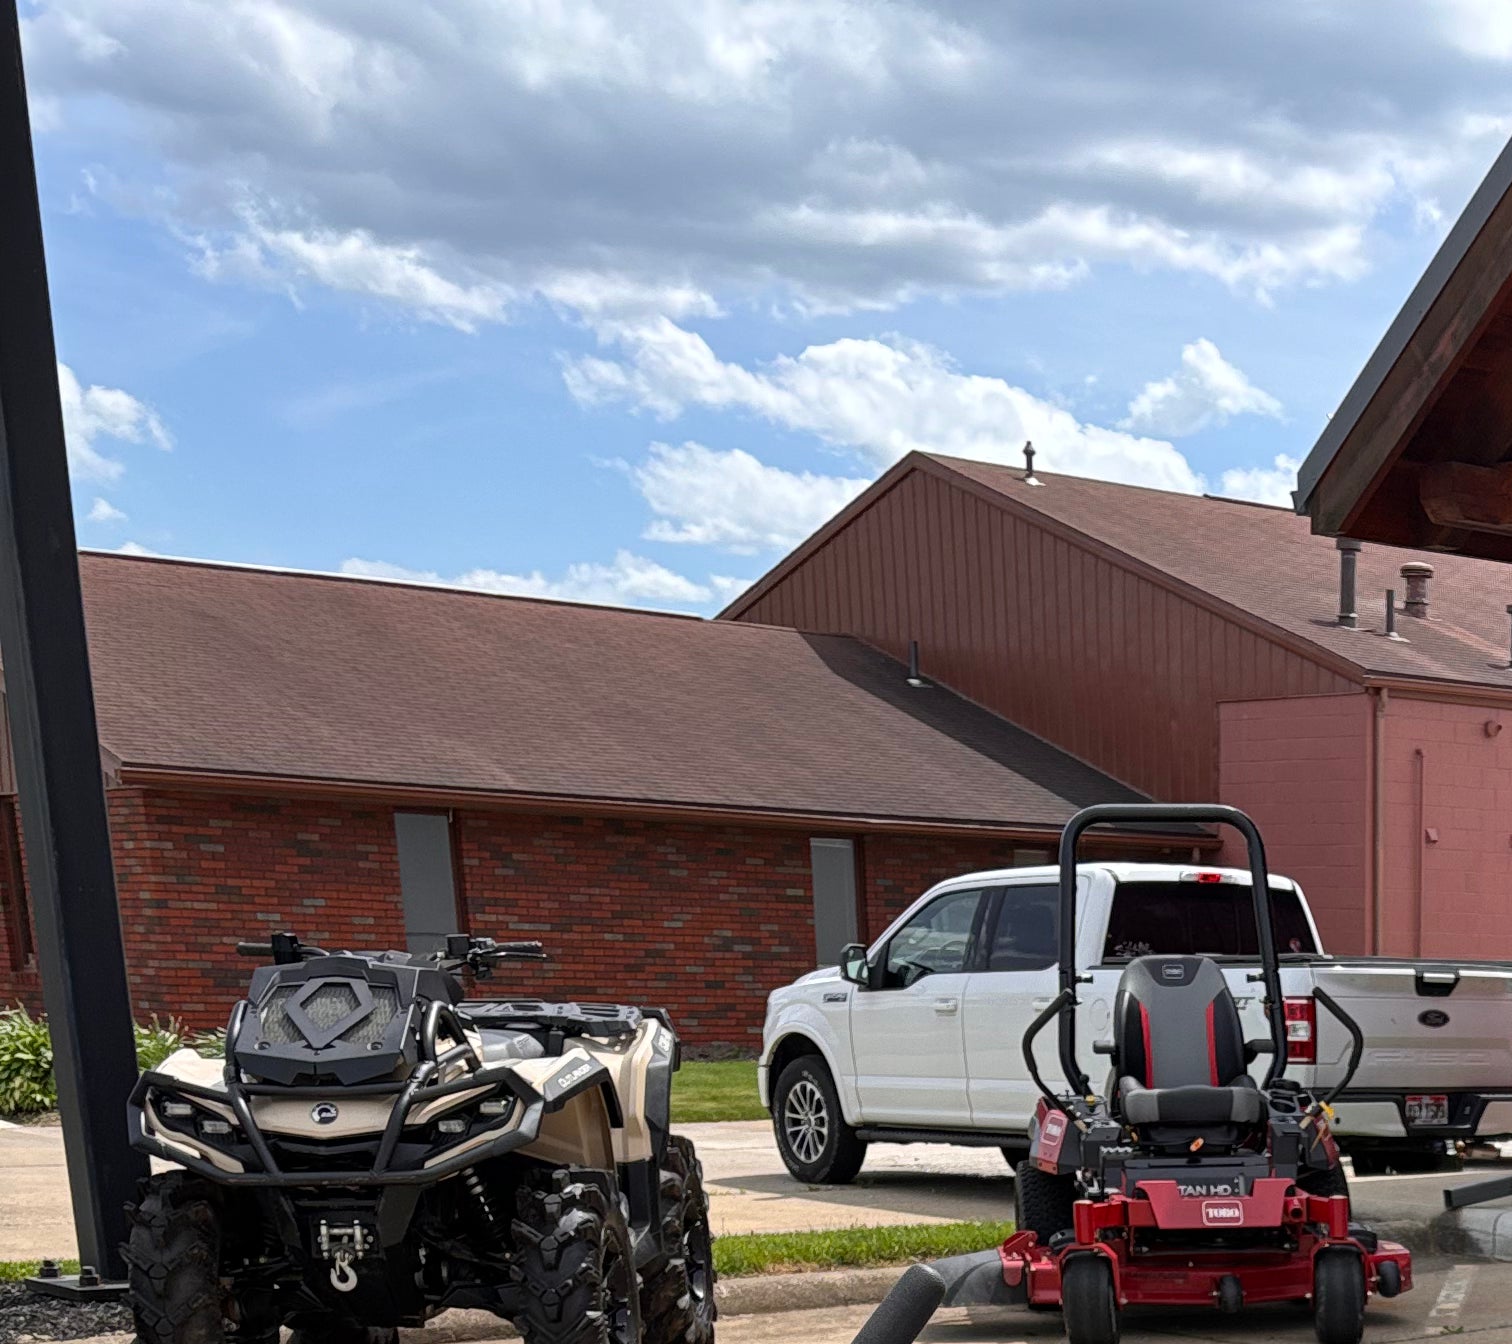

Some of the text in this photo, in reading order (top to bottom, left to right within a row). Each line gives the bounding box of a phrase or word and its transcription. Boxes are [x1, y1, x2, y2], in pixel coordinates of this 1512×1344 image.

[1177, 1184, 1232, 1196] TAN HD
[1205, 1207, 1240, 1218] TORO
